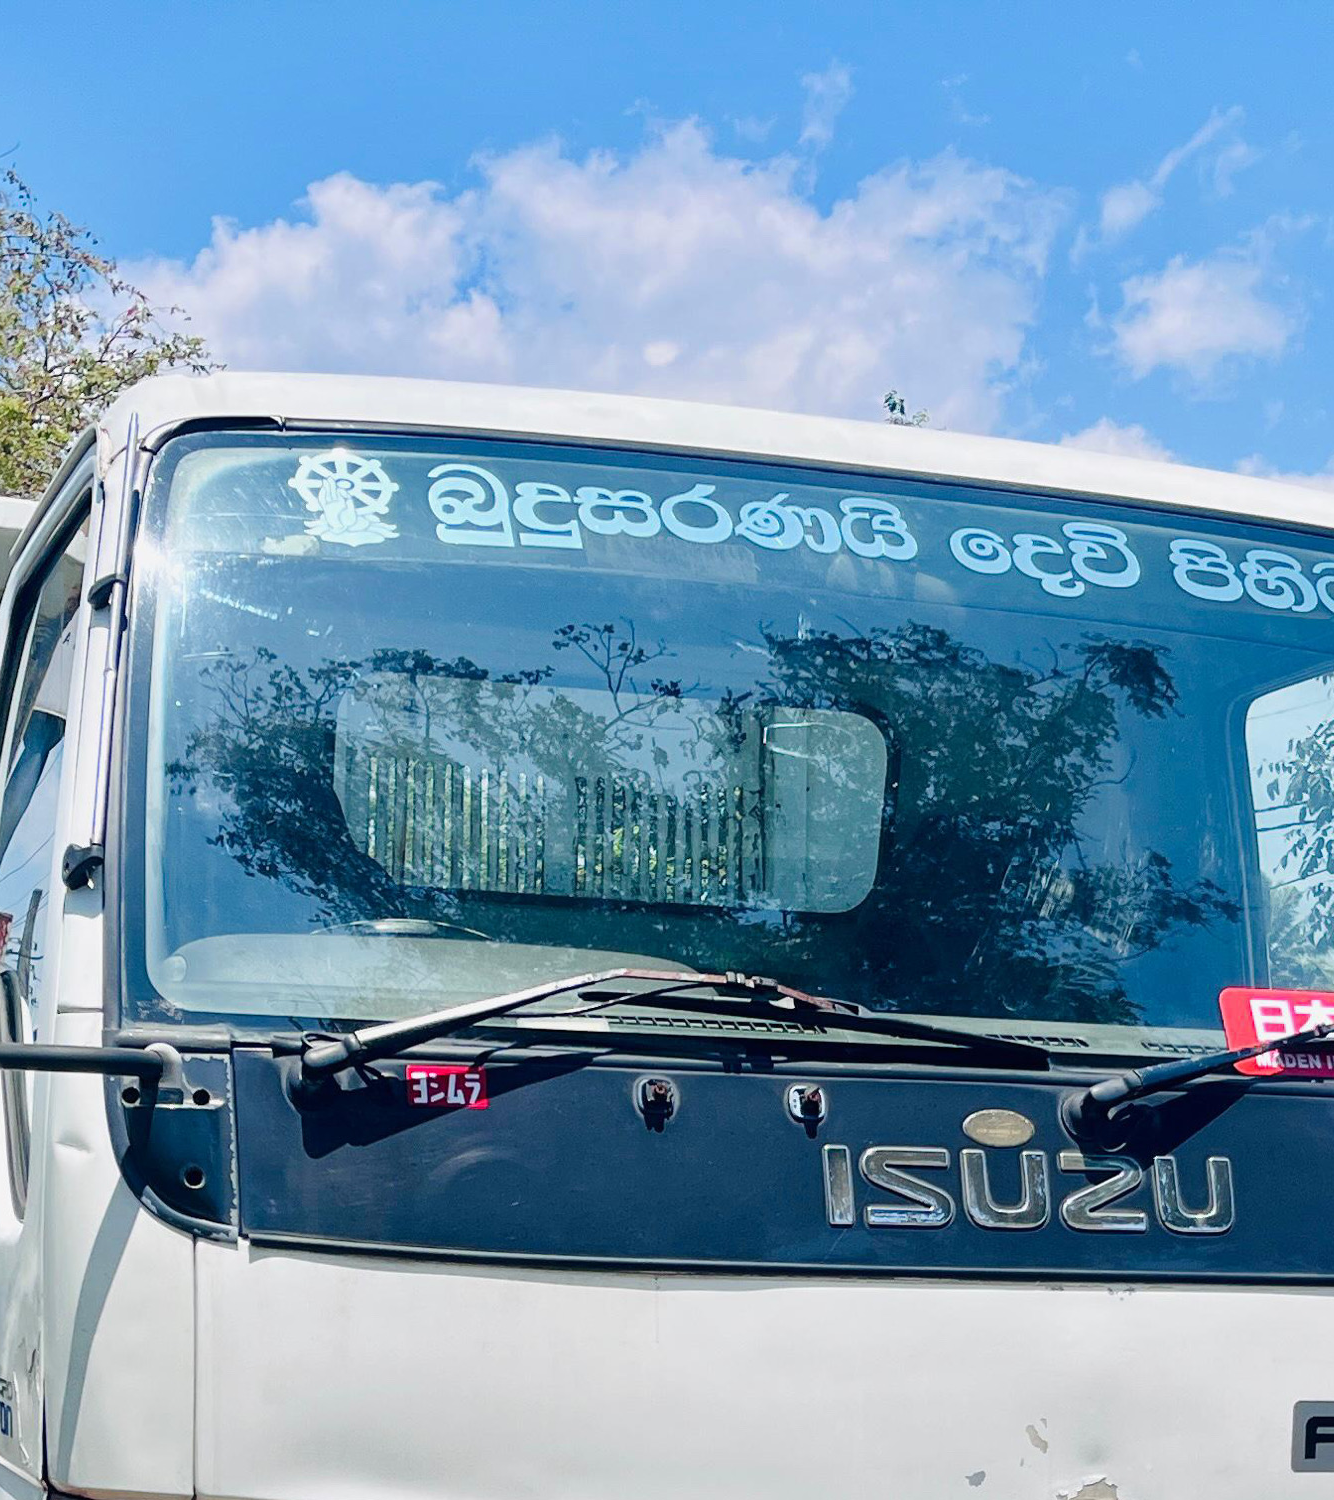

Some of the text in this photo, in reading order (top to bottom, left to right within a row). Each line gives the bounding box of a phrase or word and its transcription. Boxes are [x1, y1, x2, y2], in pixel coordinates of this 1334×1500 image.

[410, 1071, 481, 1105] ヨシムラ
[821, 1143, 1235, 1234] ISUZU
